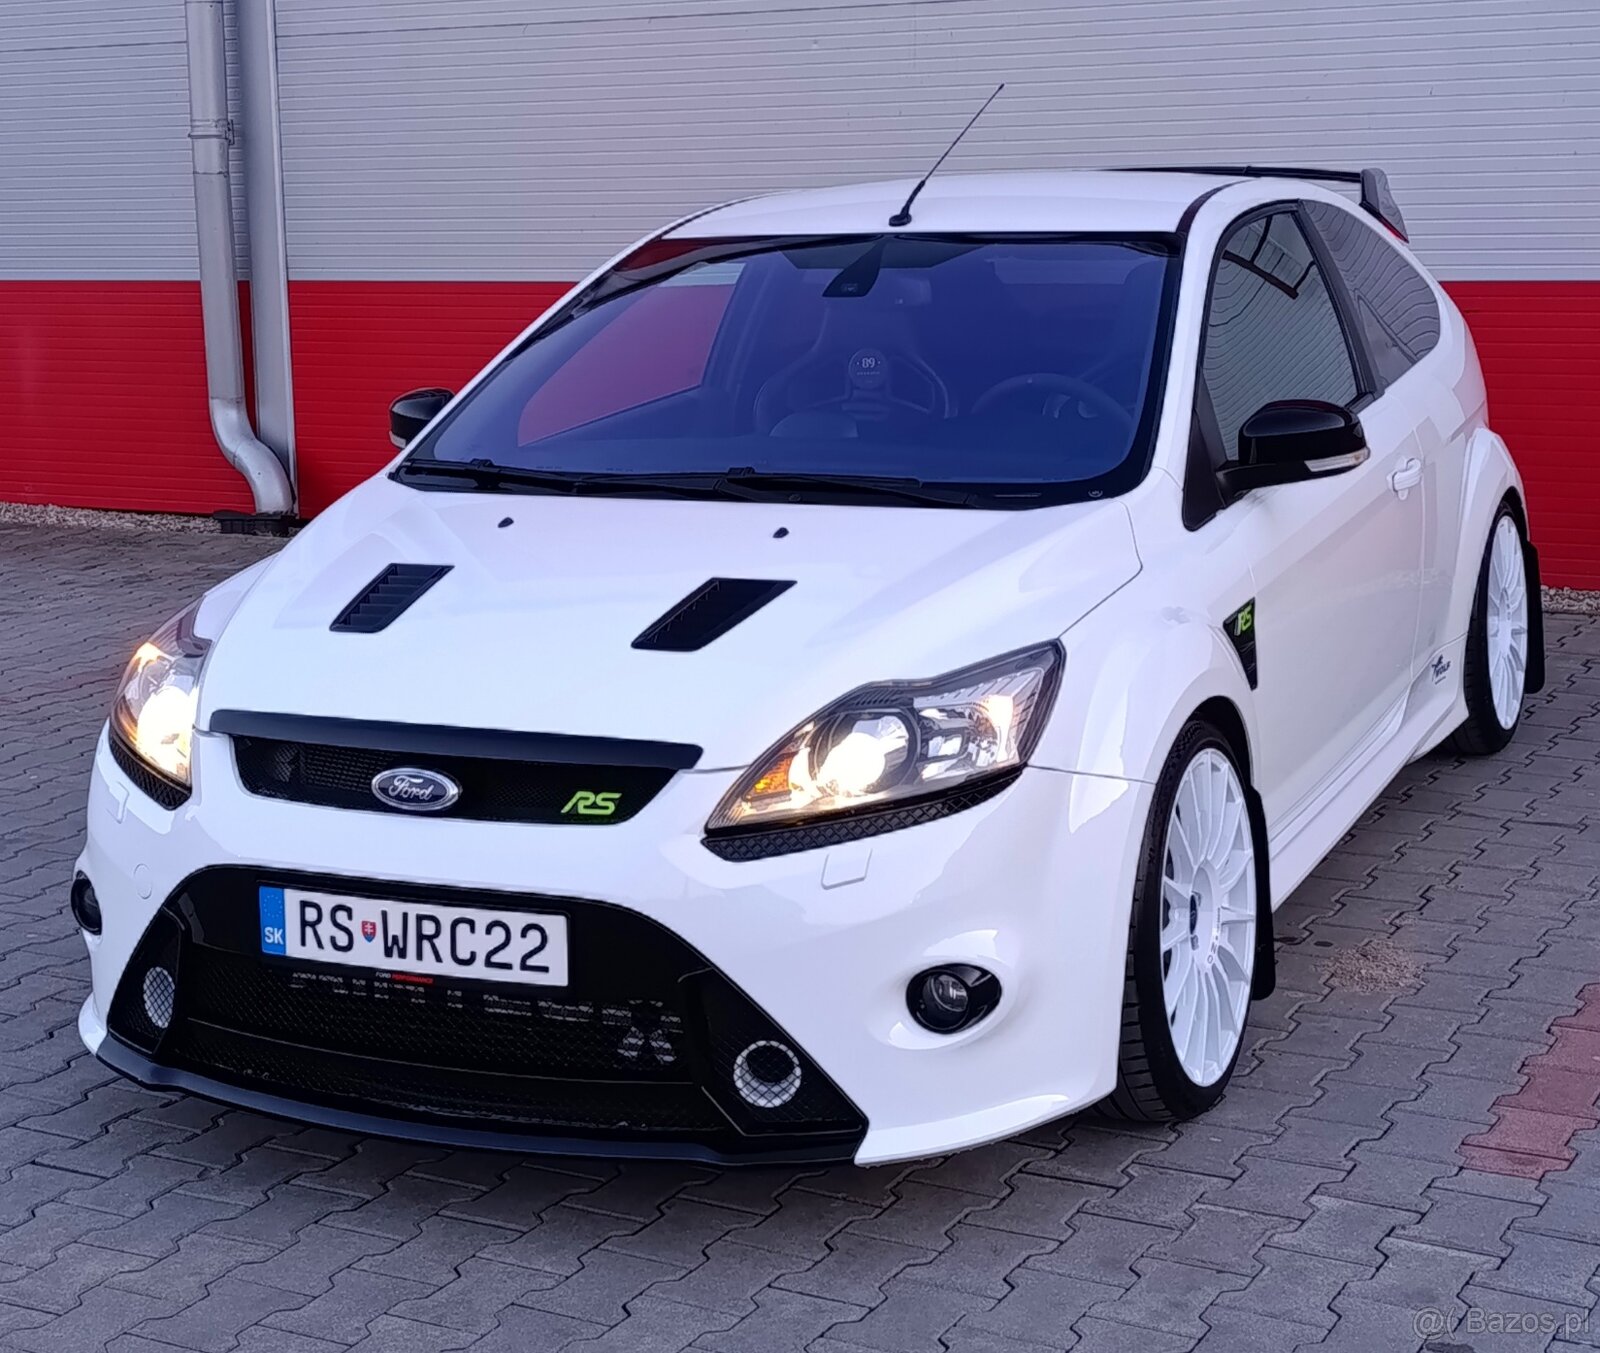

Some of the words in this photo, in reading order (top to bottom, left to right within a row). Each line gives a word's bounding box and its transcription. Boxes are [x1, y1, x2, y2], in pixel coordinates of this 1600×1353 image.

[1234, 604, 1253, 636] RS
[388, 775, 434, 801] Ford
[561, 791, 622, 815] RS
[264, 926, 285, 945] SK
[299, 900, 353, 952] RS
[381, 910, 550, 973] WRC22
[375, 970, 391, 979] FORD
